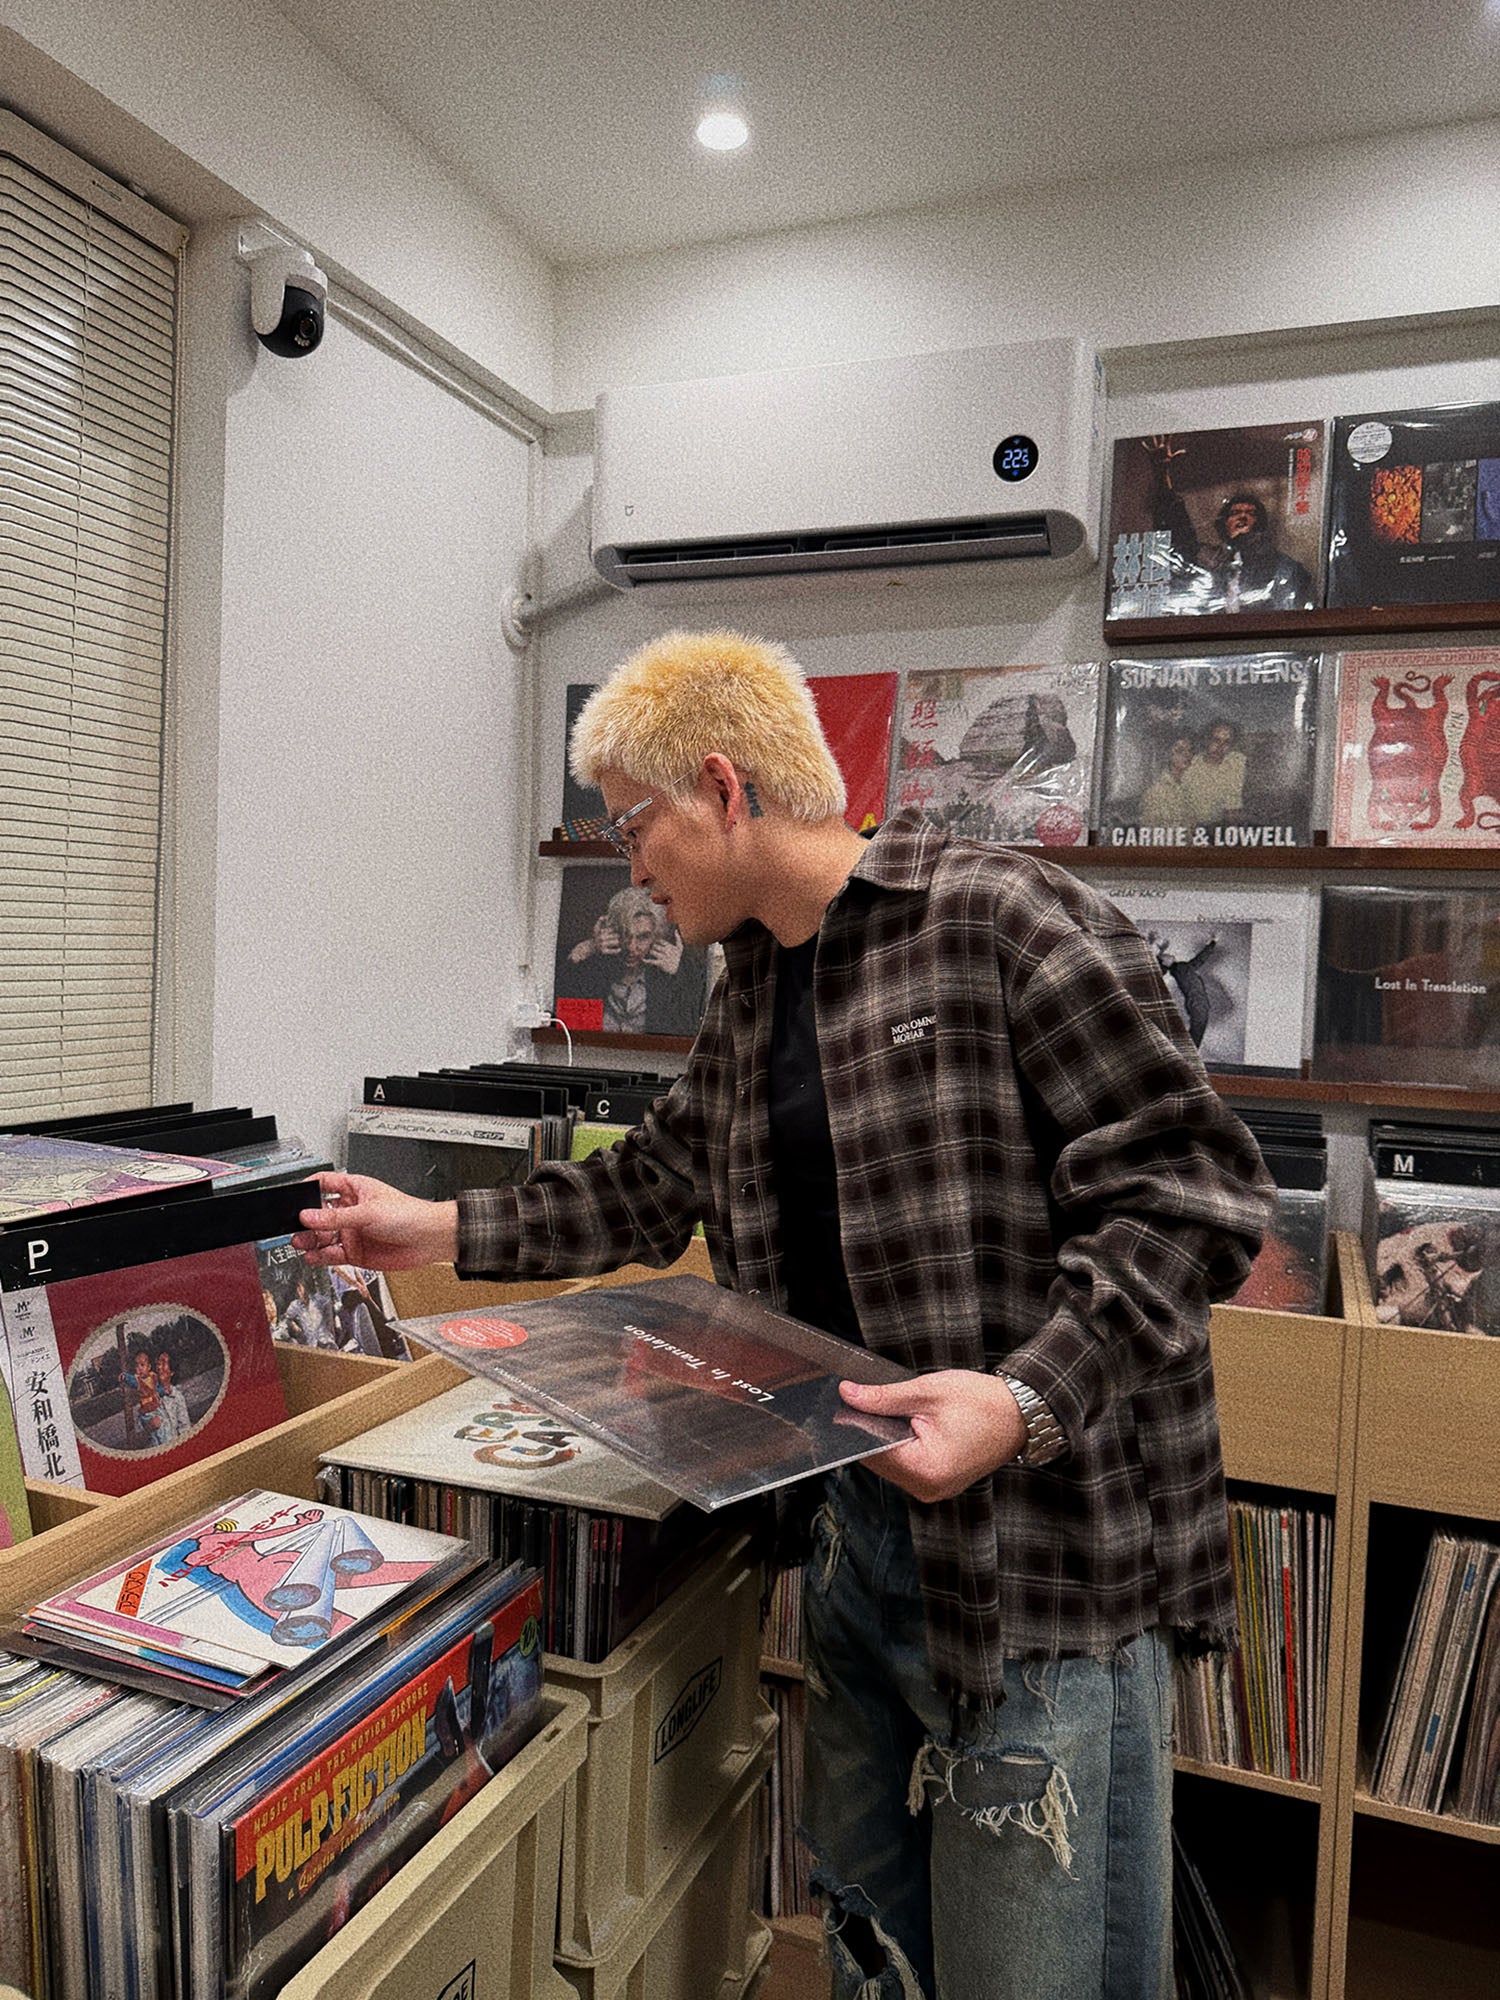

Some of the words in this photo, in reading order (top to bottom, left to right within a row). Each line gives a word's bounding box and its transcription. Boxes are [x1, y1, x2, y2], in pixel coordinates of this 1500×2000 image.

[1120, 666, 1198, 689] SUFJAN
[1209, 661, 1303, 686] STEVENS
[1112, 827, 1187, 847] CARRIE
[1193, 827, 1210, 847] &
[1214, 827, 1297, 848] LOWELL
[1374, 977, 1401, 990] Lost
[1405, 978, 1418, 991] In
[1421, 978, 1487, 994] Translation
[891, 1022, 910, 1036] NON
[373, 1083, 387, 1099] A
[597, 1100, 610, 1115] C
[1393, 1154, 1414, 1174] M
[27, 1239, 50, 1270] P
[624, 1324, 707, 1369] Translation
[711, 1367, 732, 1380] In
[731, 1379, 775, 1402] Lost
[25, 1371, 66, 1480] 安和橋北
[661, 1667, 717, 1751] LONGLIFE
[253, 1797, 288, 1836] MUSIC
[293, 1769, 322, 1802] FROM
[327, 1752, 347, 1774] THE
[351, 1717, 387, 1750] MOTION
[391, 1682, 429, 1722] PICTURE
[255, 1790, 328, 1904] PULP
[332, 1705, 427, 1836] FICTION
[299, 1850, 336, 1890] Quentin
